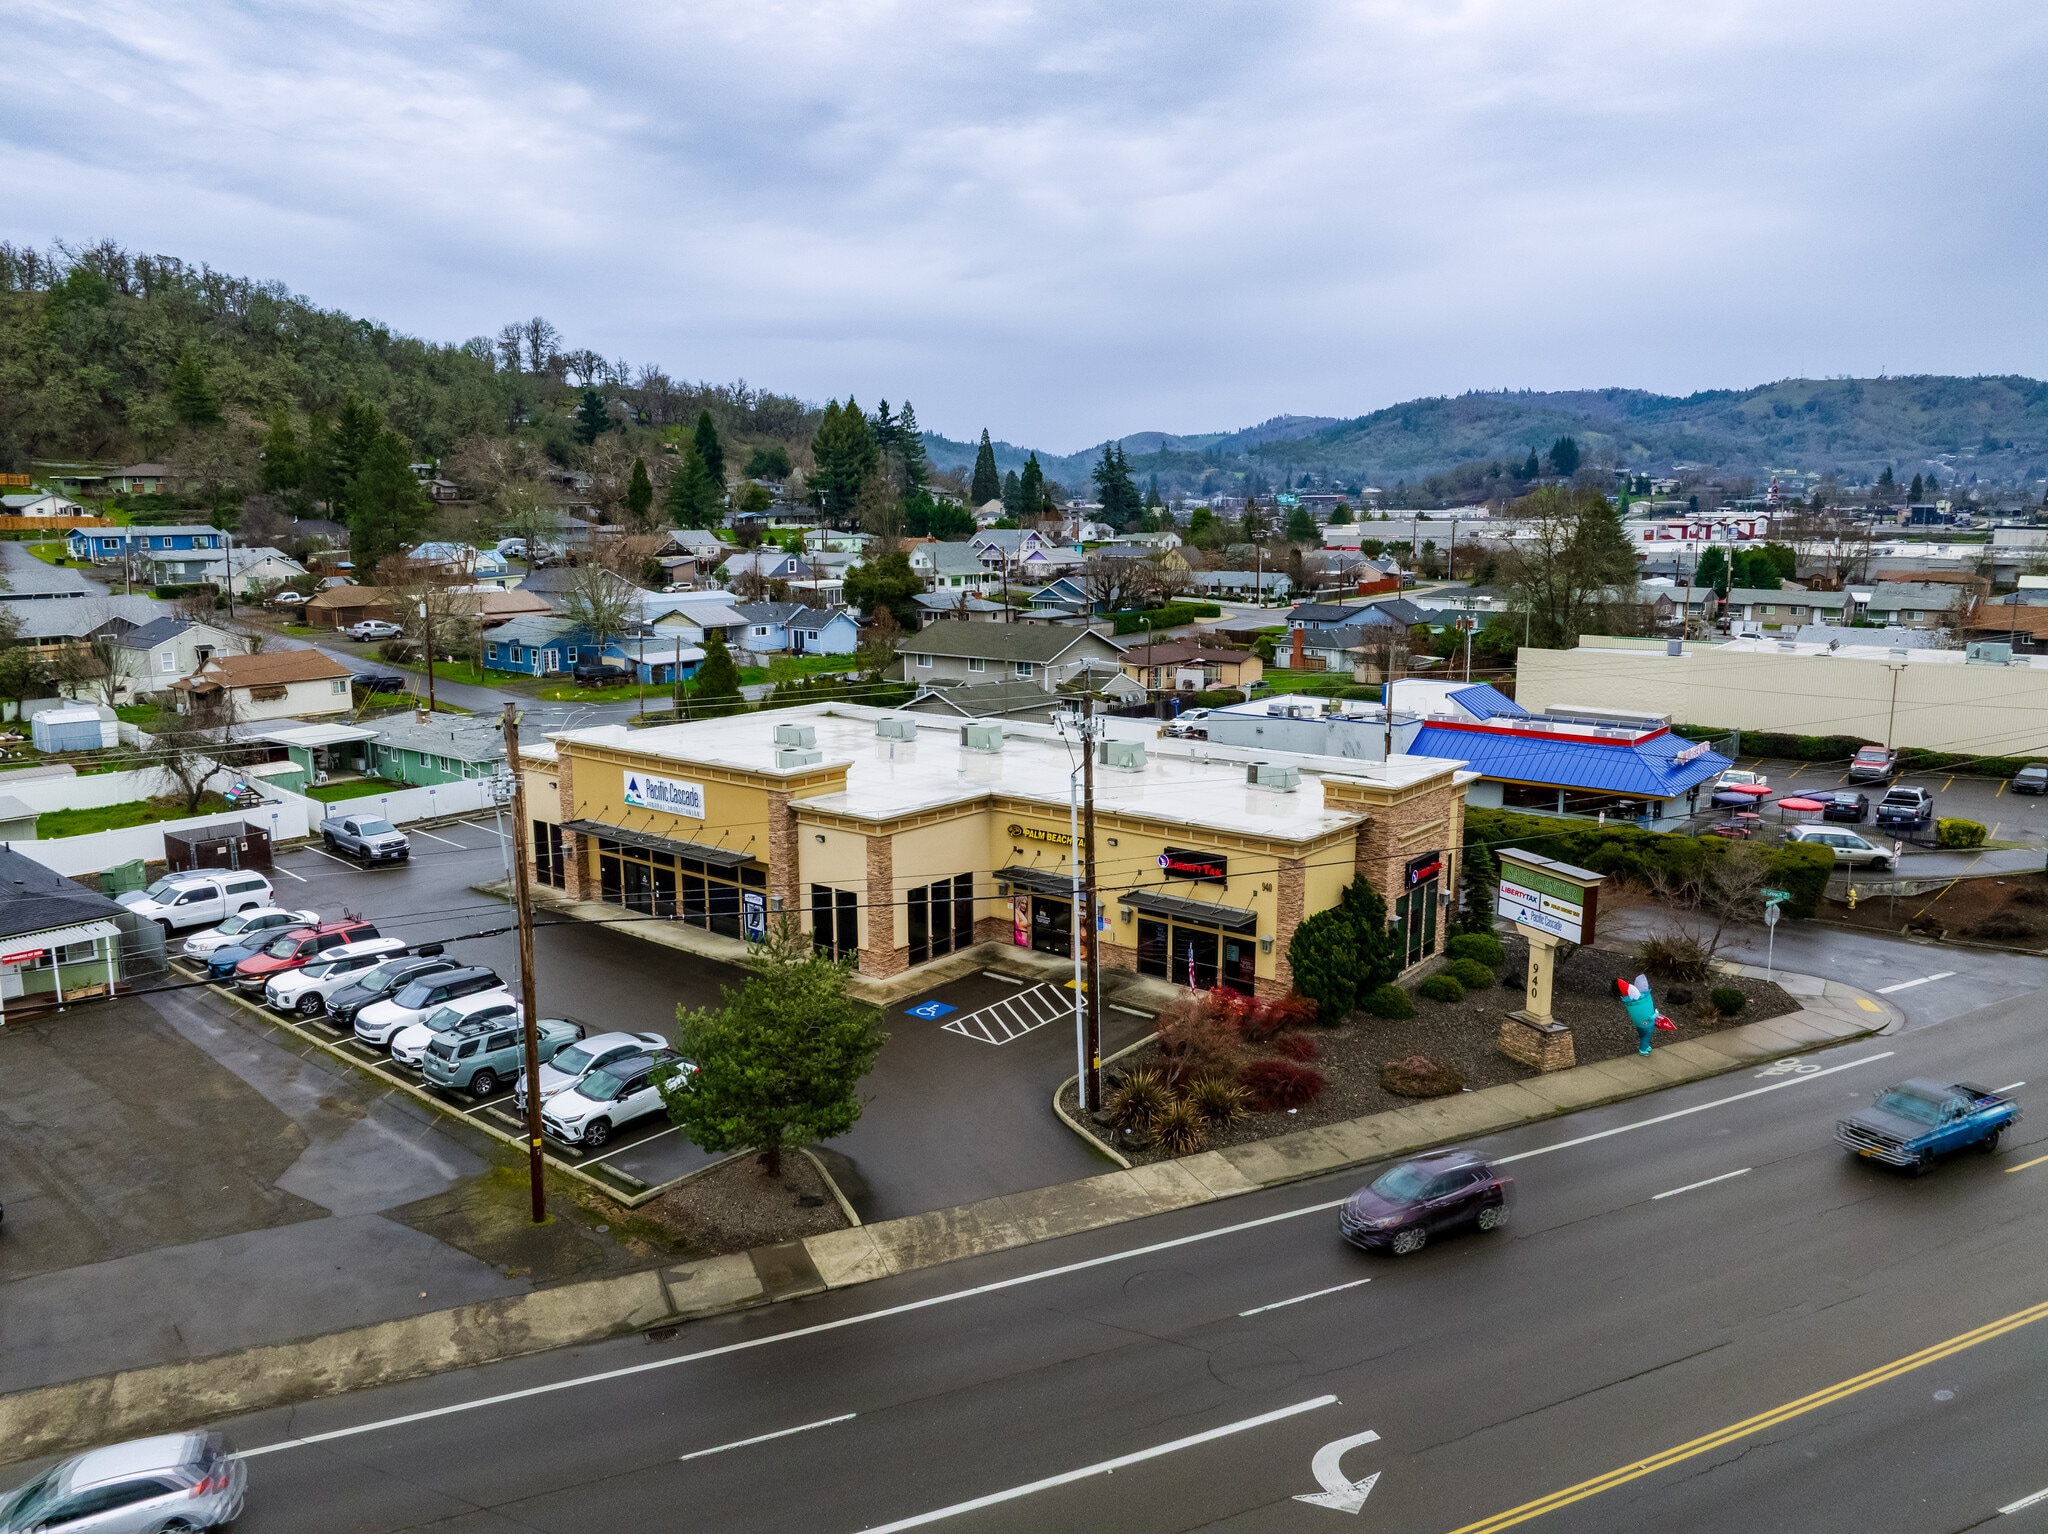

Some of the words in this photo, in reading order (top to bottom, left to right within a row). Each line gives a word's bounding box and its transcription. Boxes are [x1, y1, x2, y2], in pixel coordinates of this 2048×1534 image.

[646, 778, 669, 801] Pacific
[669, 782, 699, 808] Cascade
[1024, 828, 1046, 840] PALM
[1046, 832, 1073, 845] BEACH
[1262, 882, 1273, 893] 940
[1507, 866, 1535, 885] SAGE
[1534, 876, 1578, 902] CENTER
